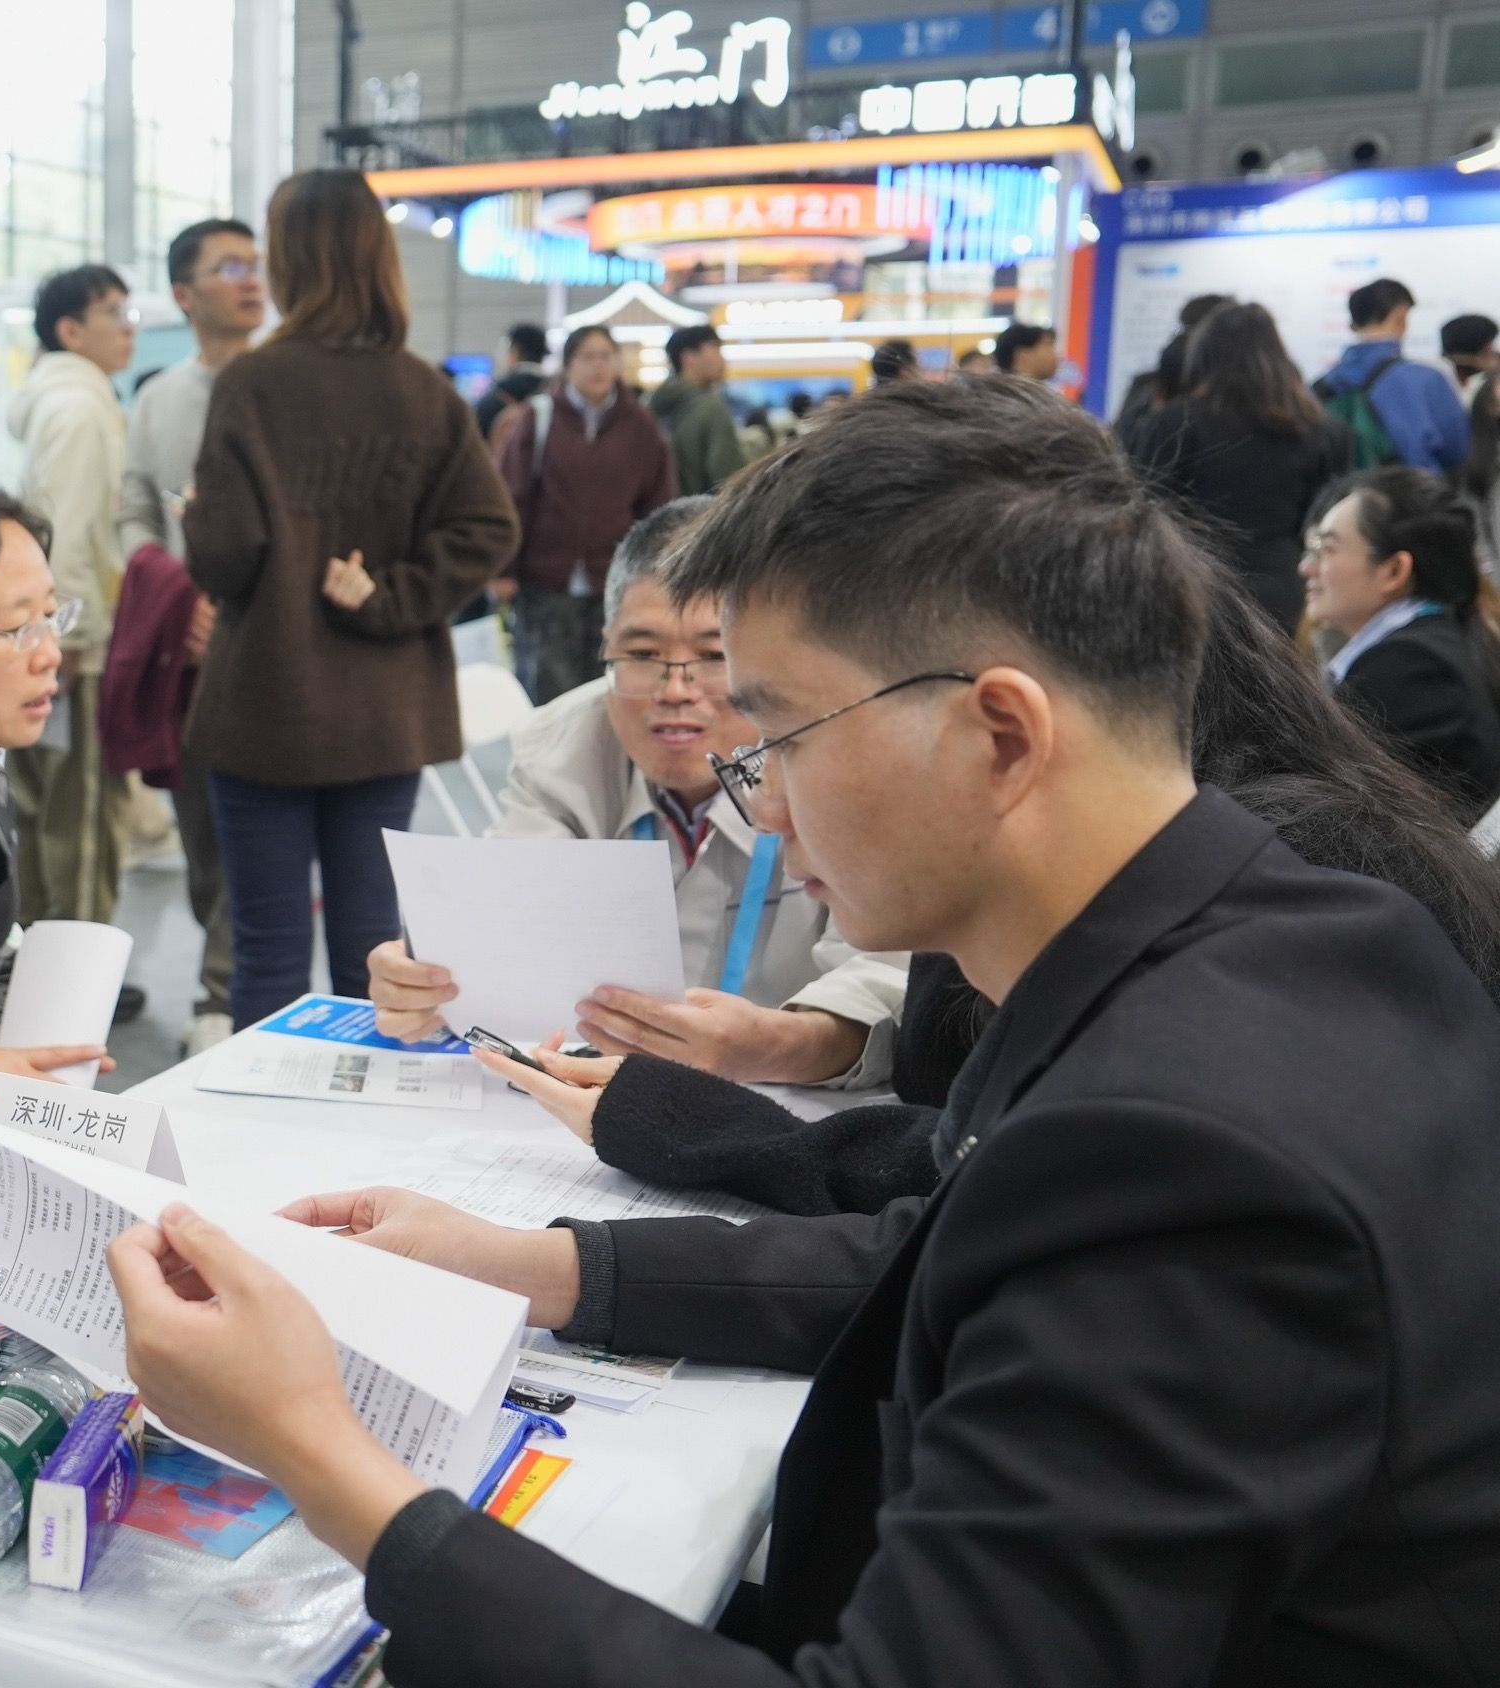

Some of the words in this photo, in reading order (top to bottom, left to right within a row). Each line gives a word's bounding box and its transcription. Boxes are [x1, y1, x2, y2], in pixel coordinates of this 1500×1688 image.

[617, 2, 790, 106] 江门
[10, 1094, 127, 1144] 深圳·龙岗
